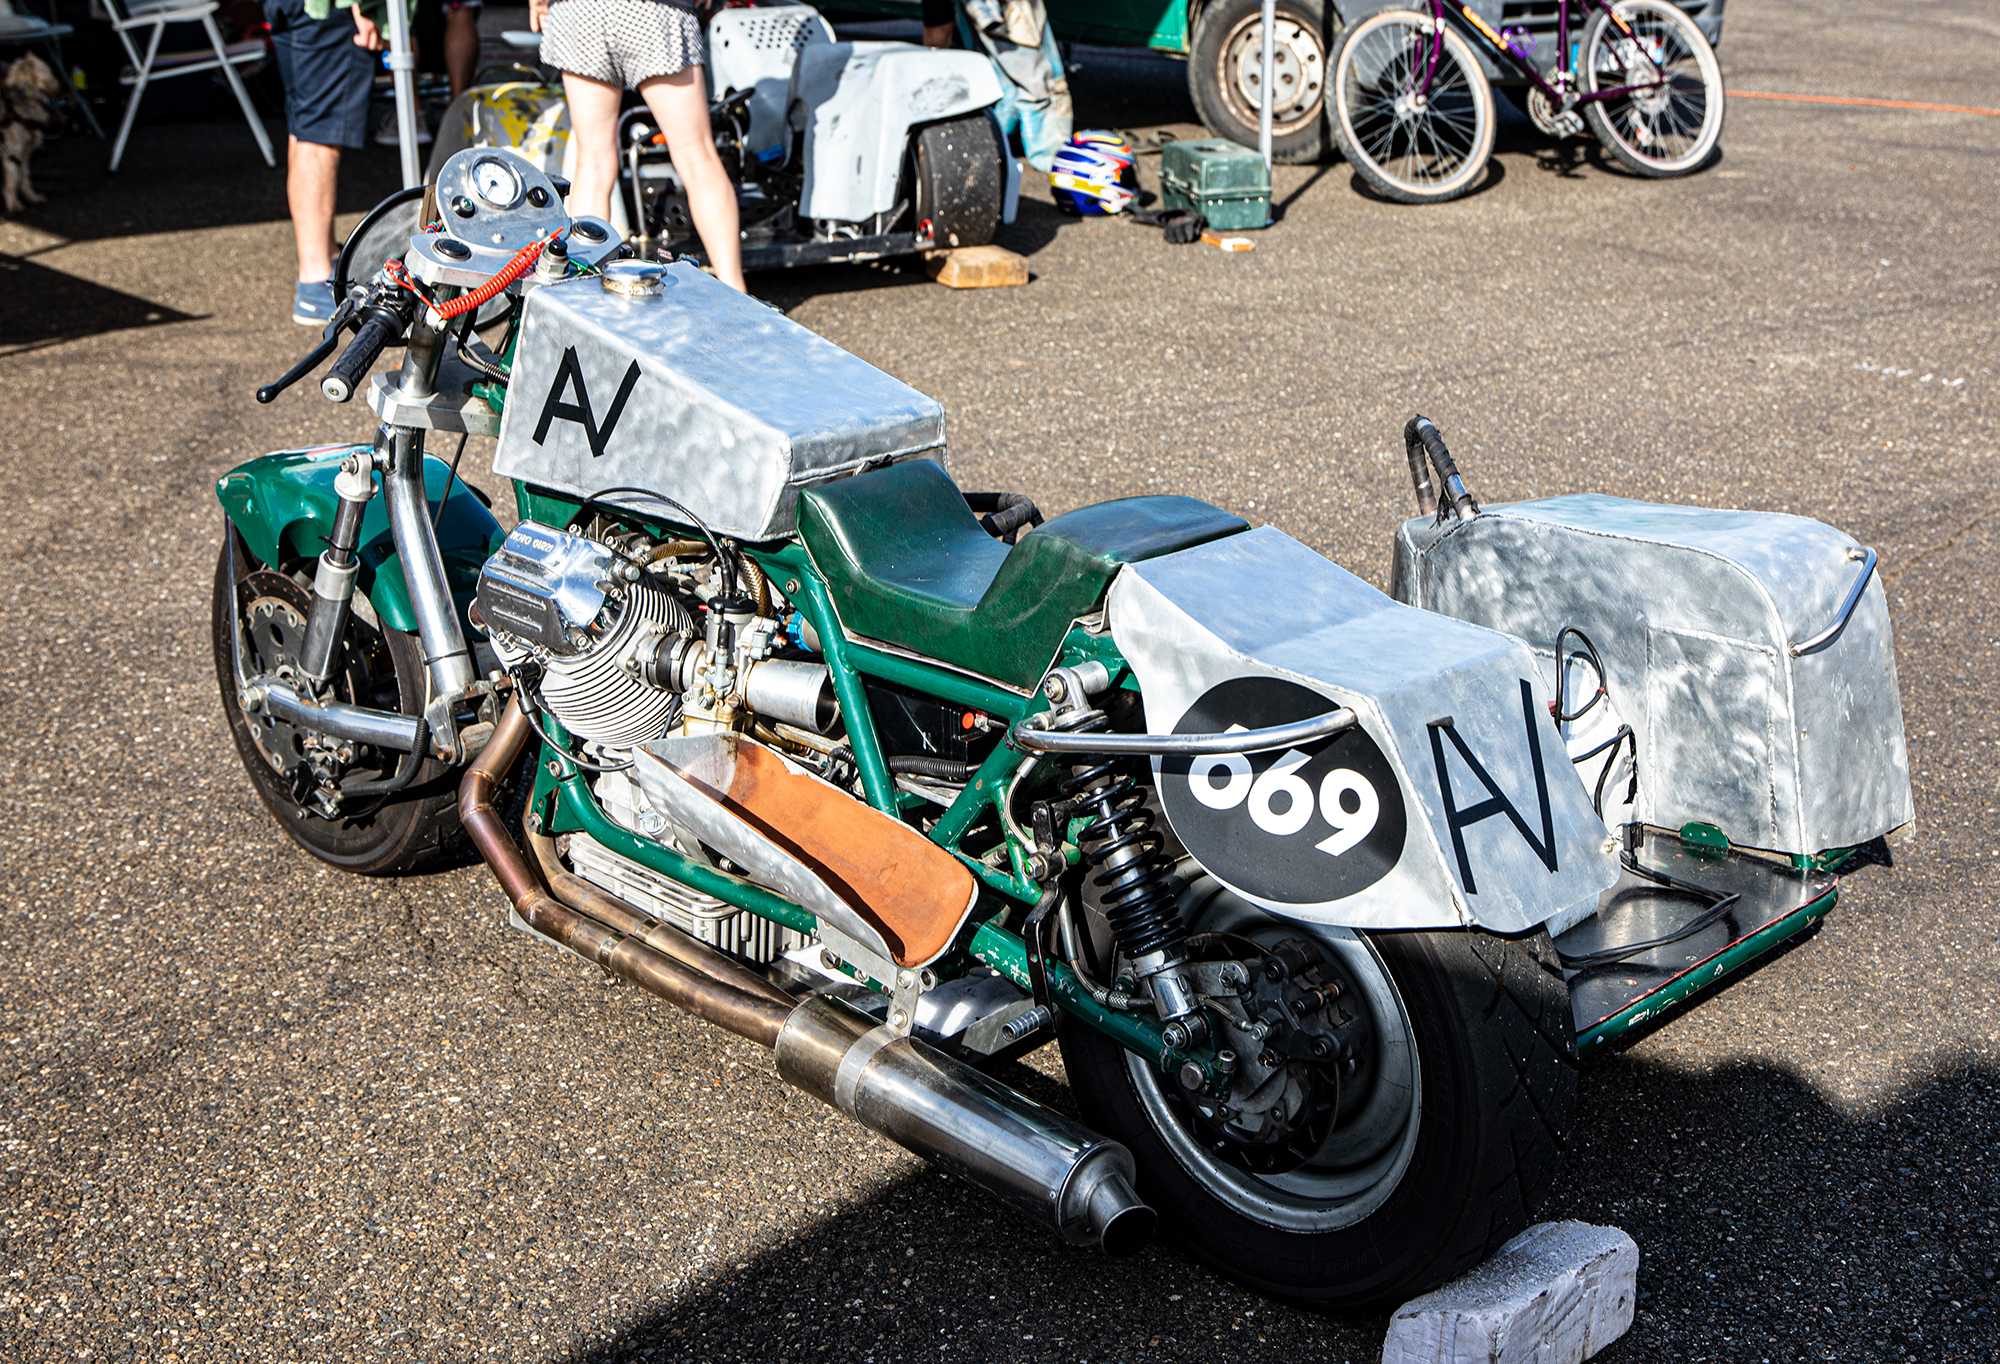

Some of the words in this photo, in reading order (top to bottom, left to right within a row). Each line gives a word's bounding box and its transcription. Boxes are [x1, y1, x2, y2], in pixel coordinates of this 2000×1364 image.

[532, 345, 642, 458] AV
[510, 530, 532, 545] MOTO
[1188, 723, 1380, 857] 669
[1426, 677, 1559, 896] AV
[1412, 980, 1450, 1104] YOKOHAMA
